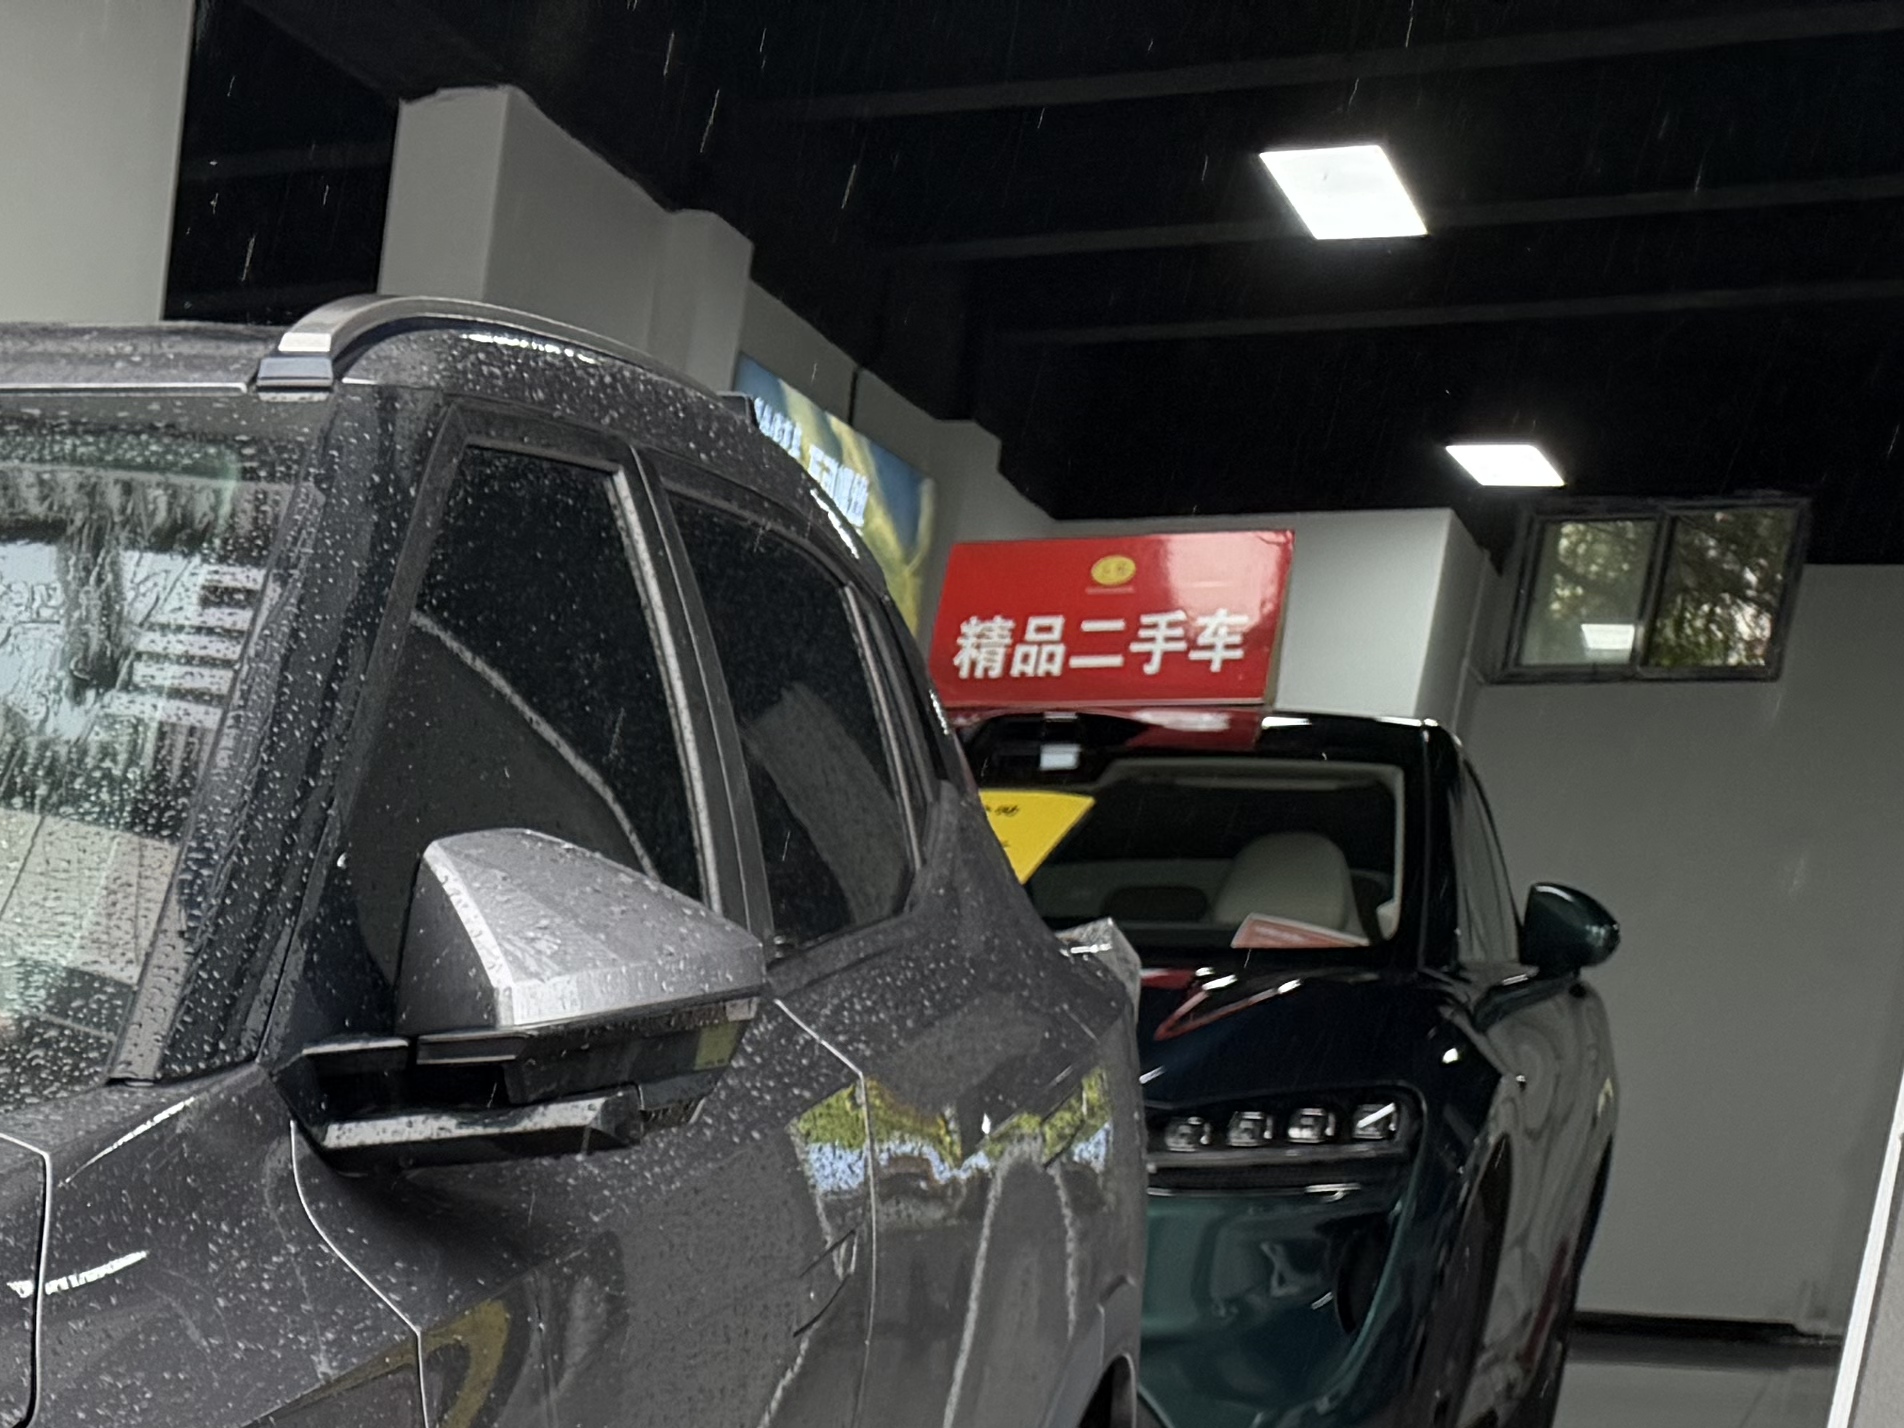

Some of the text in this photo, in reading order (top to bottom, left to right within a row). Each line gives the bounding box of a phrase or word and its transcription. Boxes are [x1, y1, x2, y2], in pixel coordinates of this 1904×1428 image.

[953, 607, 1245, 680] 精品二手车
